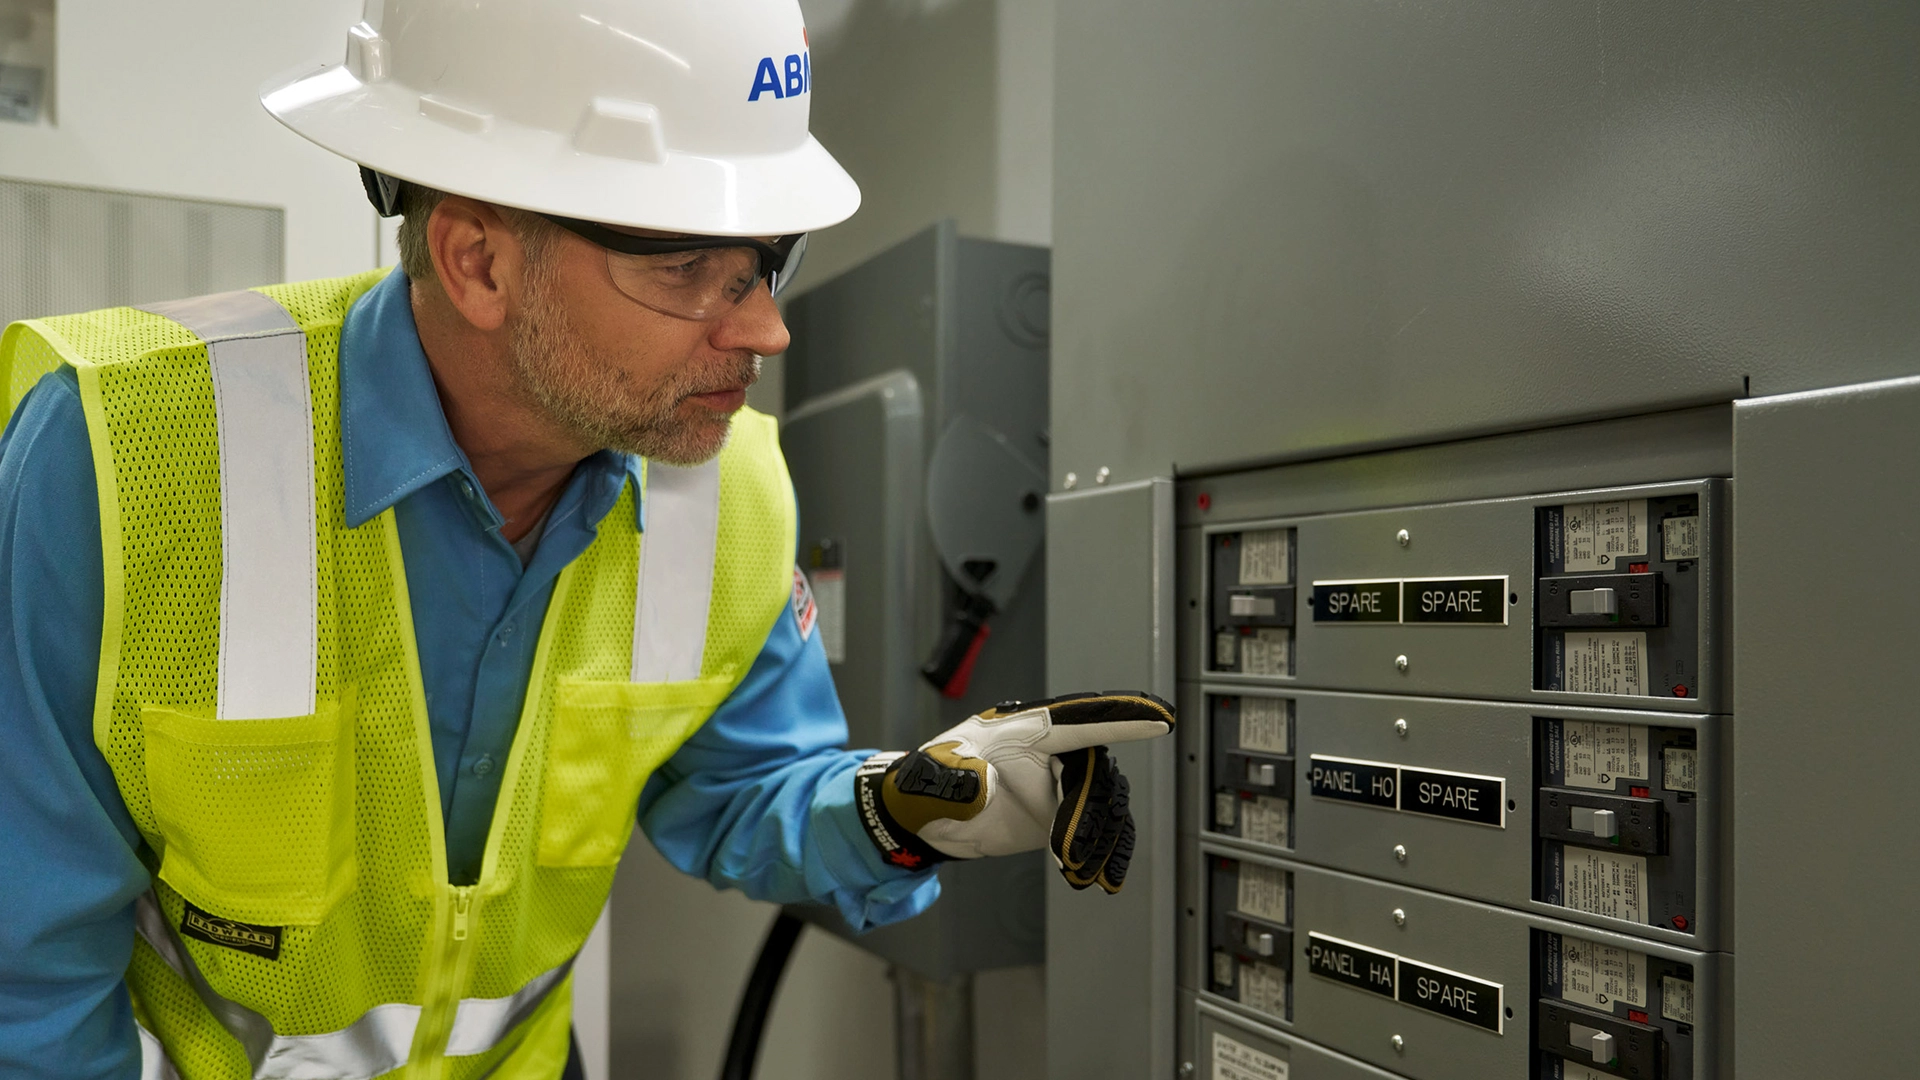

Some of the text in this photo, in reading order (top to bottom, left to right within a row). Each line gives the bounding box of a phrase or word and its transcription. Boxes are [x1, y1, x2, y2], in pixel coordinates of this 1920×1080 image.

[1329, 592, 1381, 613] SPARE
[1421, 590, 1482, 613] SPARE
[1313, 768, 1362, 793] PANEL
[860, 777, 878, 827] SAFETY
[1419, 782, 1479, 811] SPARE
[872, 829, 894, 851] MCR
[193, 916, 267, 943] RADWEAR
[1311, 946, 1392, 988] PANEL HA
[1417, 976, 1477, 1015] SPARE
